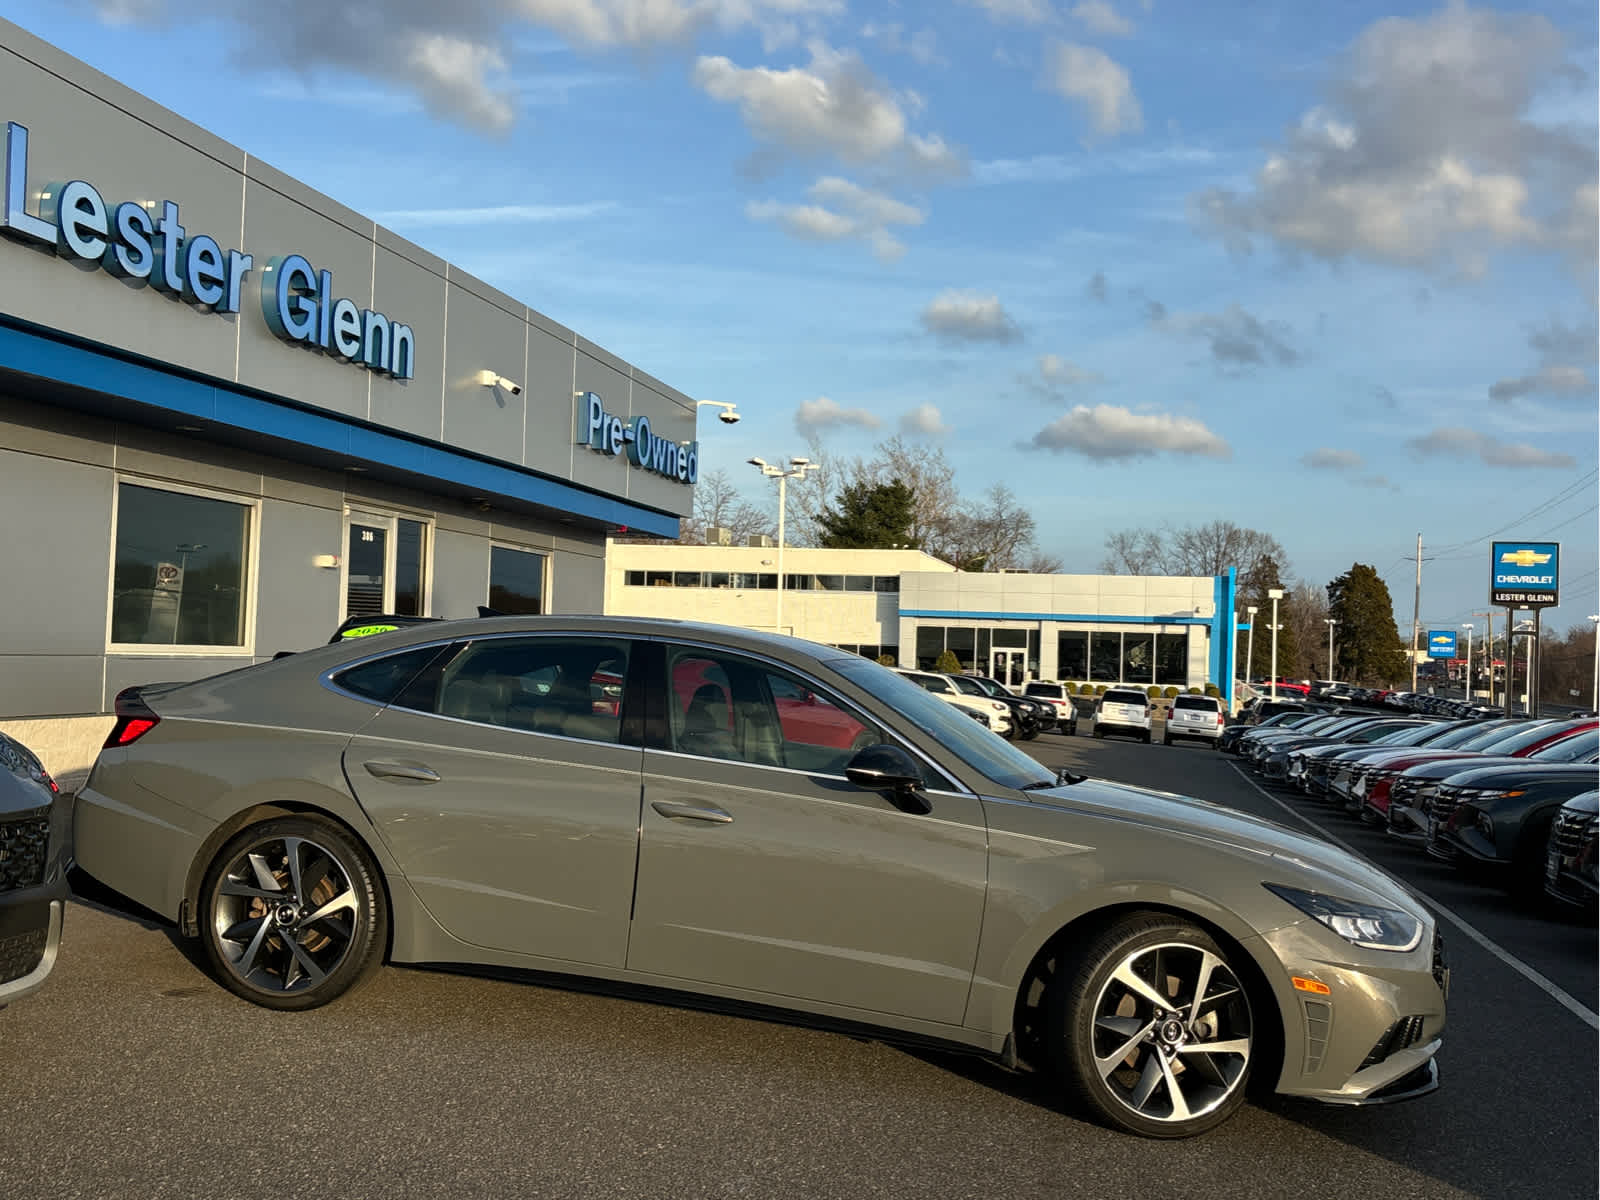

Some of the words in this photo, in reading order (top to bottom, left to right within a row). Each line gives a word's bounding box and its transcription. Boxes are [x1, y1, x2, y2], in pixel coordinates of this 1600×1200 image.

[4, 121, 254, 315] Lester
[270, 253, 416, 380] Glenn
[582, 391, 699, 484] Pre-Owned
[1495, 593, 1525, 601] LESTER
[1527, 594, 1554, 602] GLENN
[1496, 574, 1554, 584] CHEVROLET
